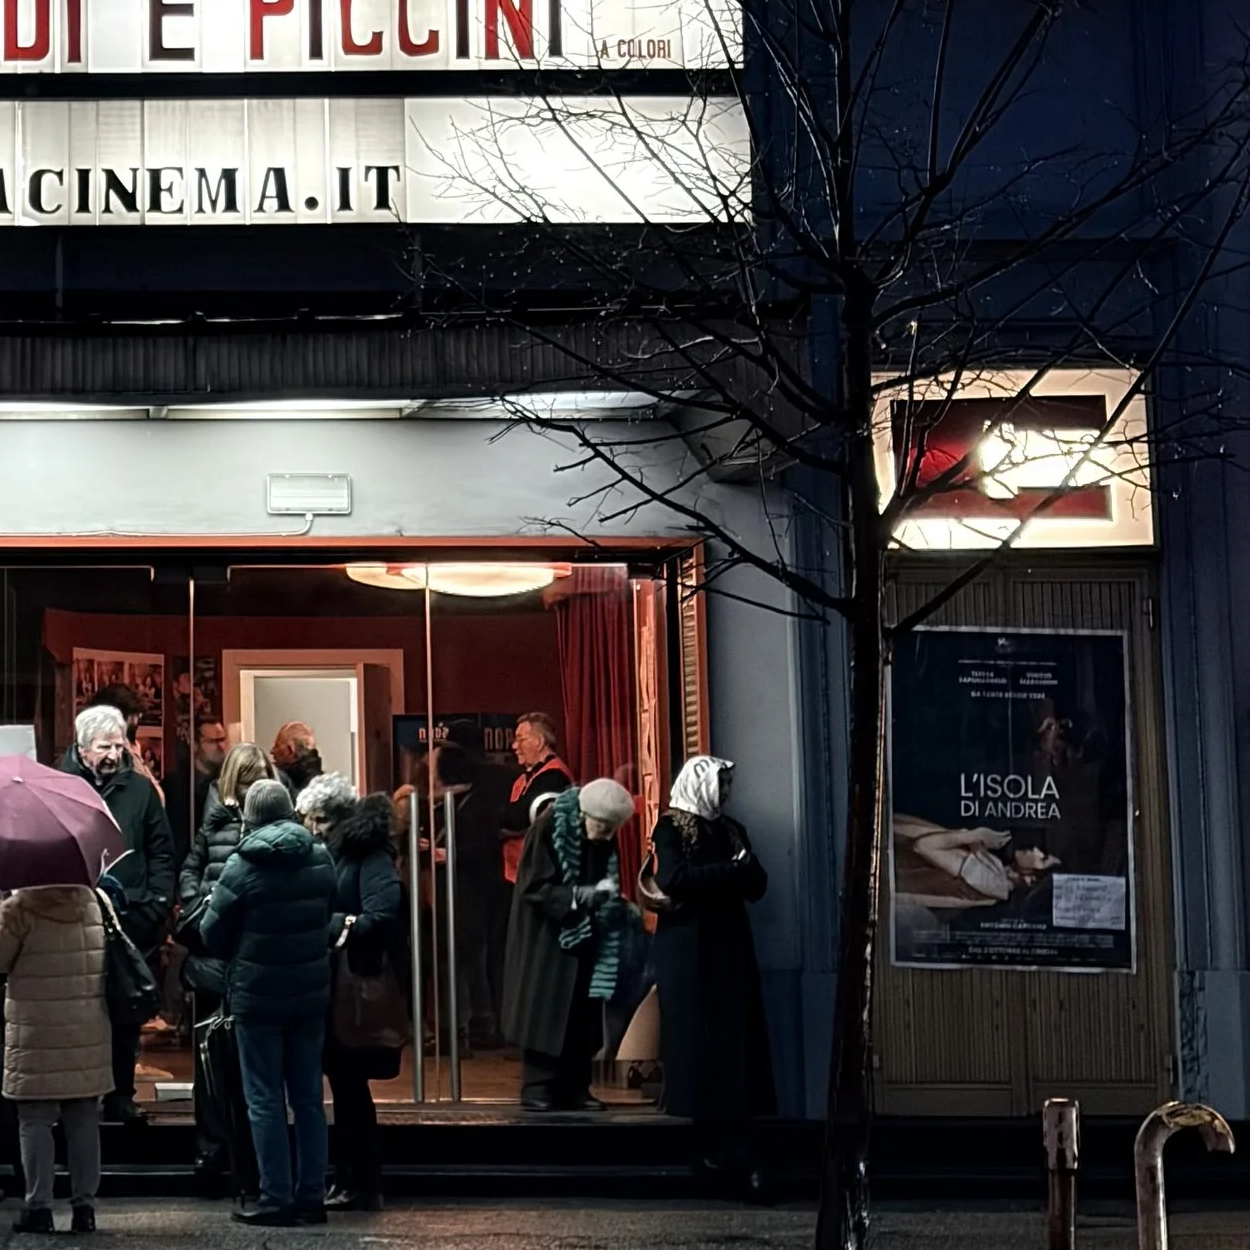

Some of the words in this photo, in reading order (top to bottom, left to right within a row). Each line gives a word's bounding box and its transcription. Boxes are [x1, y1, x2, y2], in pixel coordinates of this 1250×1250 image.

[617, 38, 672, 59] COLORI
[960, 773, 1060, 799] L'ISOLA
[961, 800, 979, 817] DI
[984, 801, 1061, 819] ANDREA
